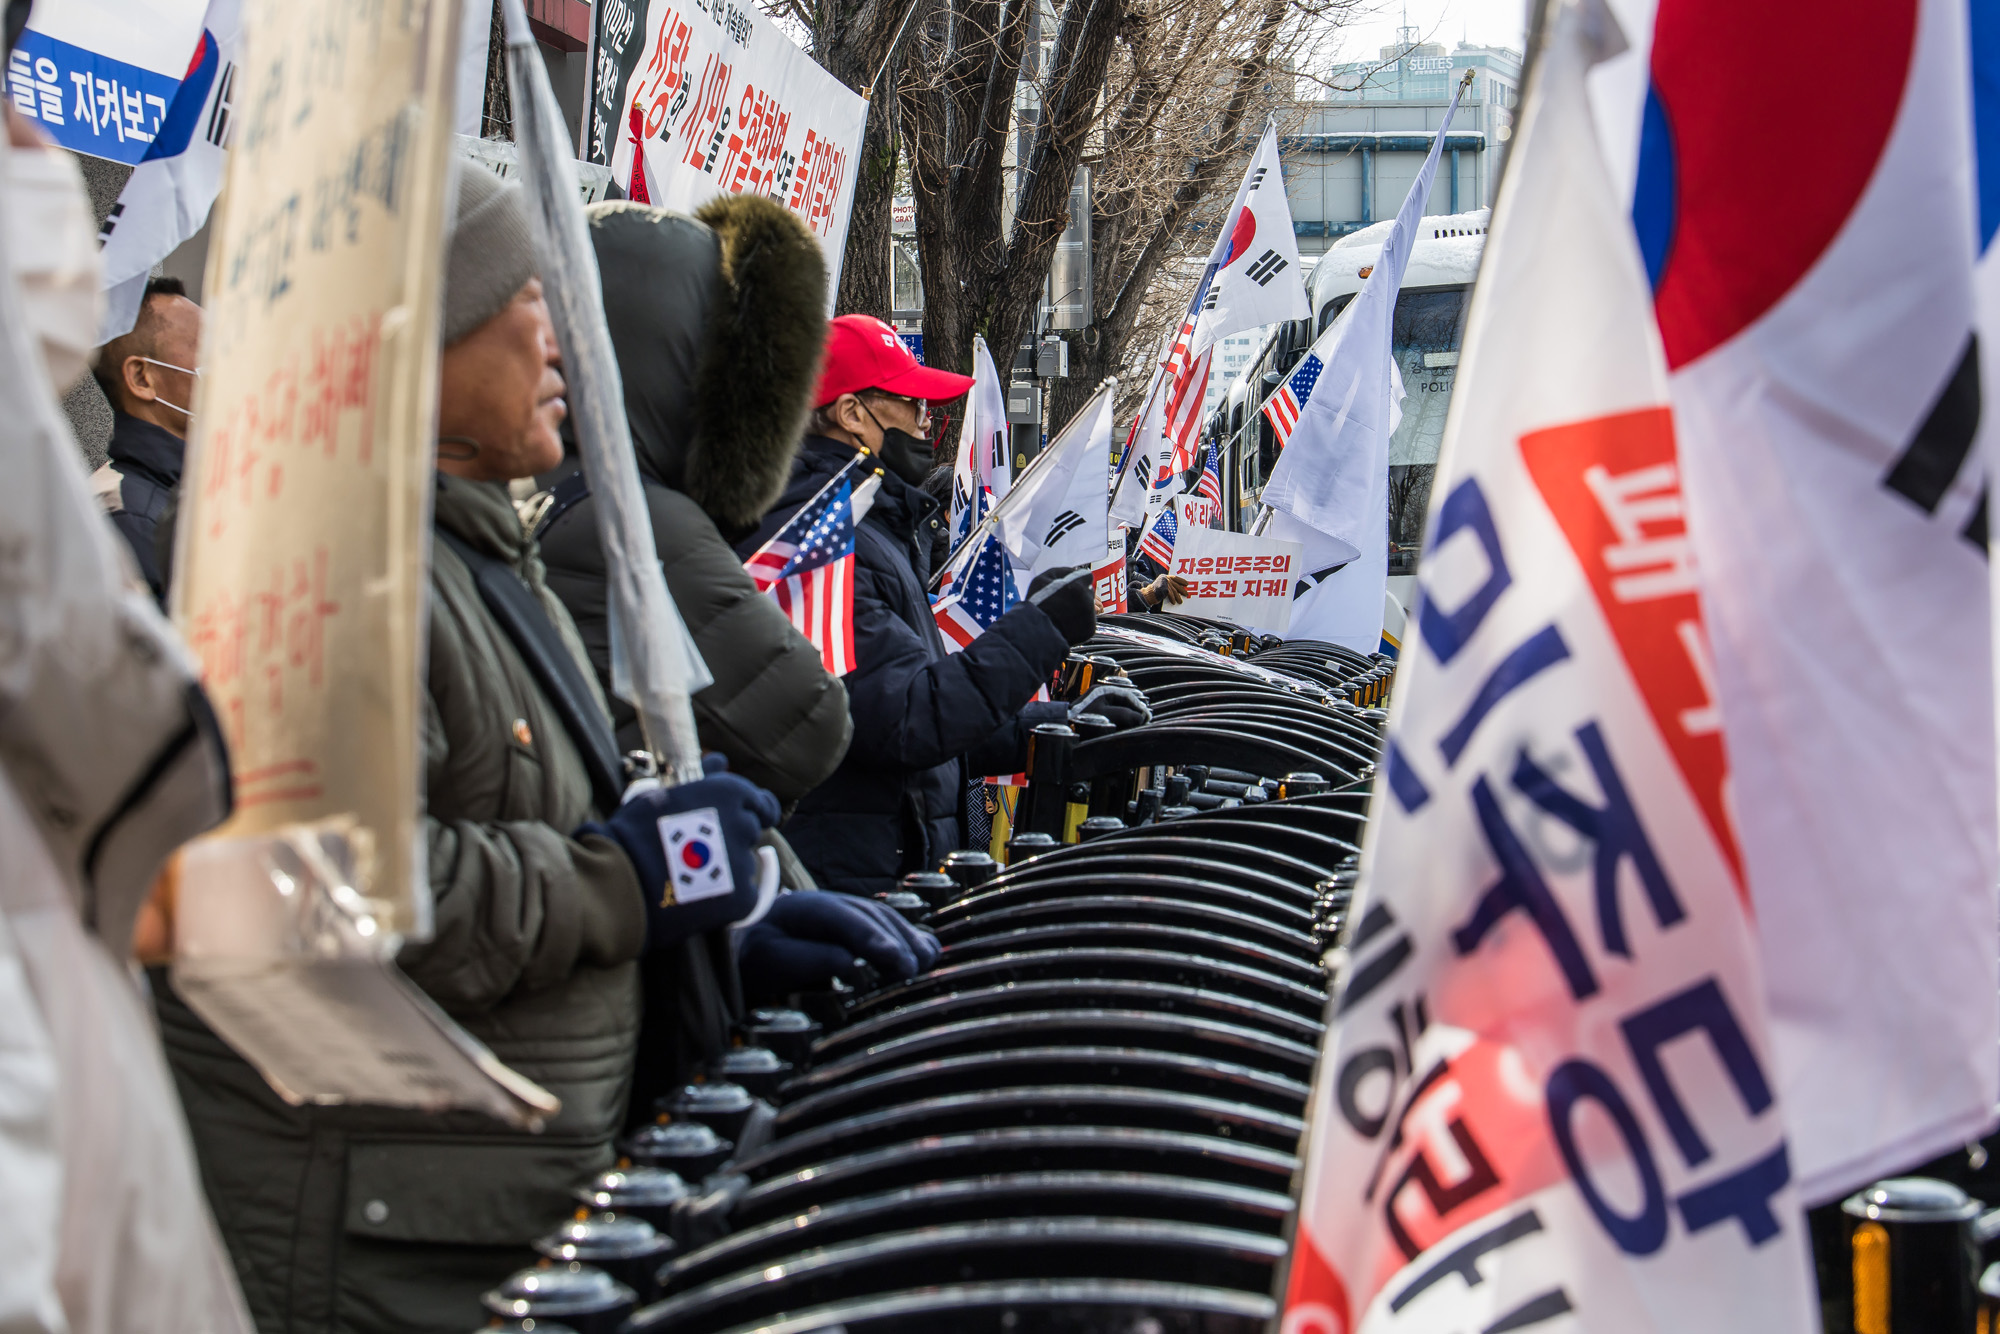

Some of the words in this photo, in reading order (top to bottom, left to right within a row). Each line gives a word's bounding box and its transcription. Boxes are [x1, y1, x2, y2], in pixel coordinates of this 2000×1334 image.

[724, 3, 753, 50] 계속할래?
[1408, 57, 1454, 71] SUITES
[1, 48, 65, 126] 들을
[69, 70, 167, 143] 지켜보고
[680, 52, 732, 173] 시민을
[895, 215, 914, 223] GRAY
[1176, 555, 1291, 575] 자유민주주의
[1242, 579, 1288, 598] 지켜!
